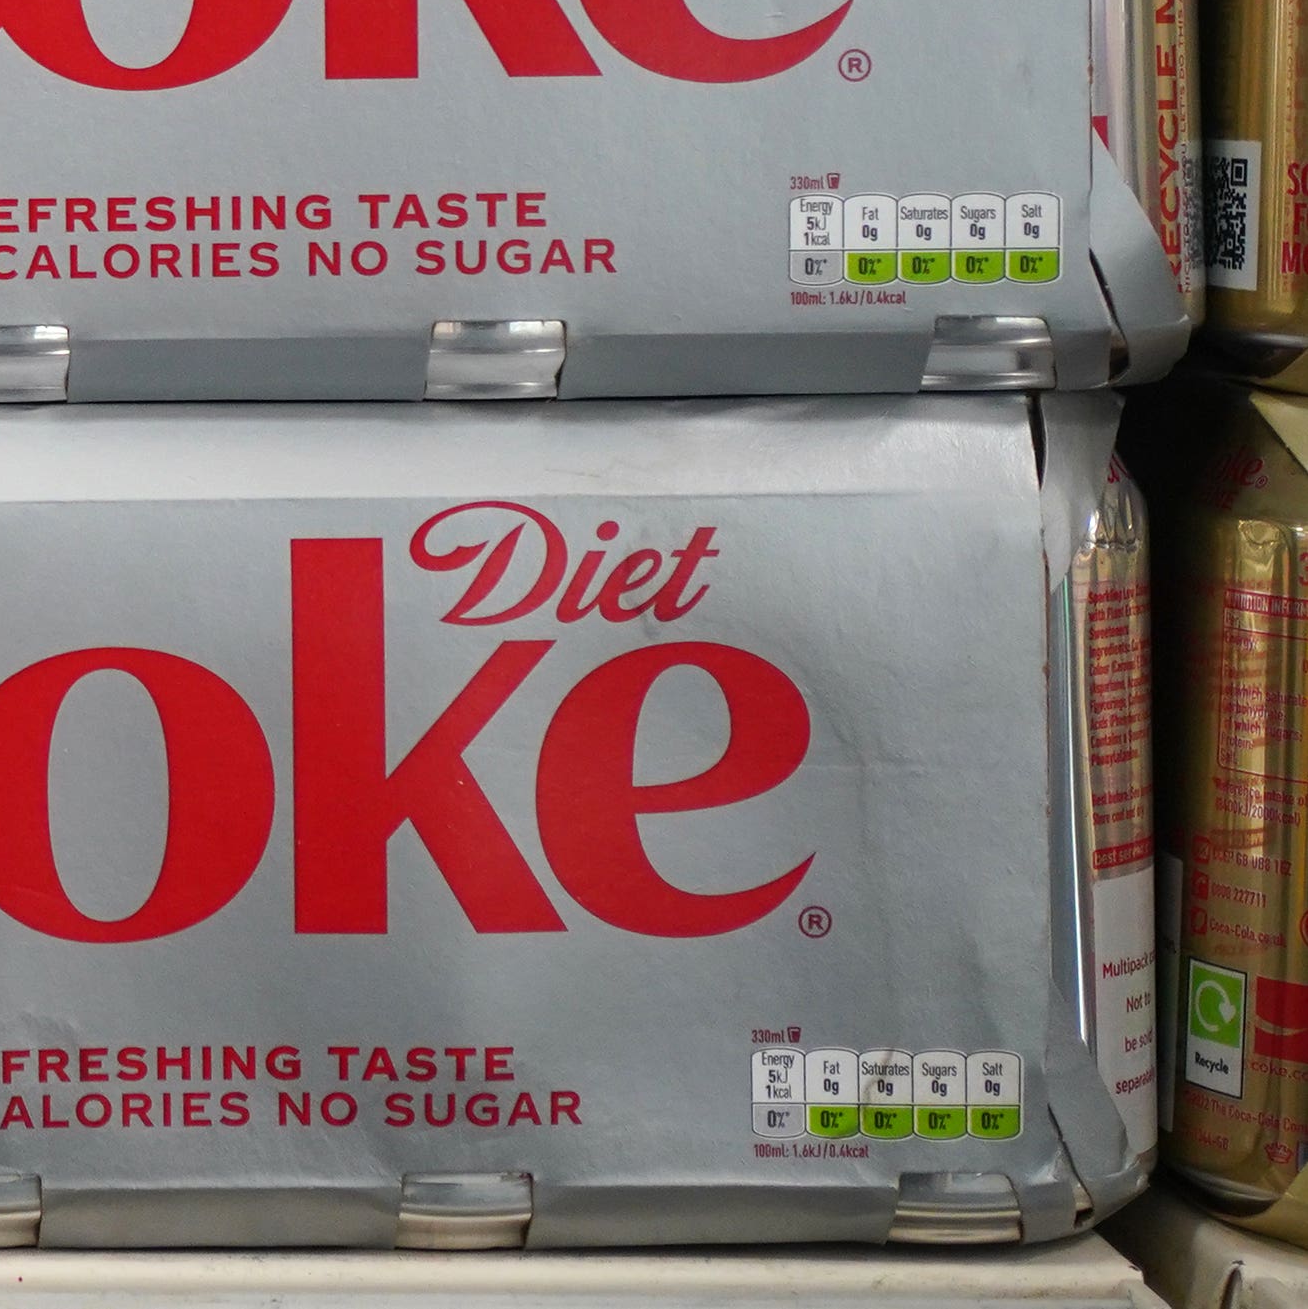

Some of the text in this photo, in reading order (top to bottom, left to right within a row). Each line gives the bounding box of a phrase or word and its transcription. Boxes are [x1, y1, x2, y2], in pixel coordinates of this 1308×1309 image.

[790, 176, 824, 190] 330ml
[359, 192, 546, 229] TASTE
[799, 199, 832, 214] Energy
[862, 207, 879, 220] Fat
[900, 207, 948, 220] Saturates
[960, 206, 996, 221] Sugars
[1022, 205, 1042, 218] Salt
[807, 217, 826, 231] 5kJ
[1024, 222, 1039, 238] 0g
[804, 233, 830, 246] 1kcal
[862, 225, 878, 241] 0g
[916, 225, 931, 240] 0g
[970, 224, 985, 240] 0g
[309, 240, 389, 277] NO
[416, 238, 615, 276] SUGAR
[790, 292, 826, 305] 100ml:
[408, 499, 717, 625] Diet
[1103, 953, 1147, 979] Multipack
[1126, 995, 1143, 1013] Not
[752, 1030, 785, 1044] 330ml
[1125, 1035, 1137, 1053] be
[328, 1045, 514, 1082] TASTE
[762, 1052, 795, 1068] Energy
[1194, 1051, 1230, 1075] Recycle
[823, 1061, 840, 1075] Fat
[861, 1062, 910, 1076] Saturates
[922, 1064, 957, 1080] Sugars
[983, 1063, 1003, 1076] Salt
[768, 1070, 788, 1083] 5kJ
[765, 1085, 792, 1100] 1kcal
[279, 1091, 358, 1127] NO
[386, 1090, 581, 1128] SUGAR
[753, 1144, 789, 1158] 100ml:
